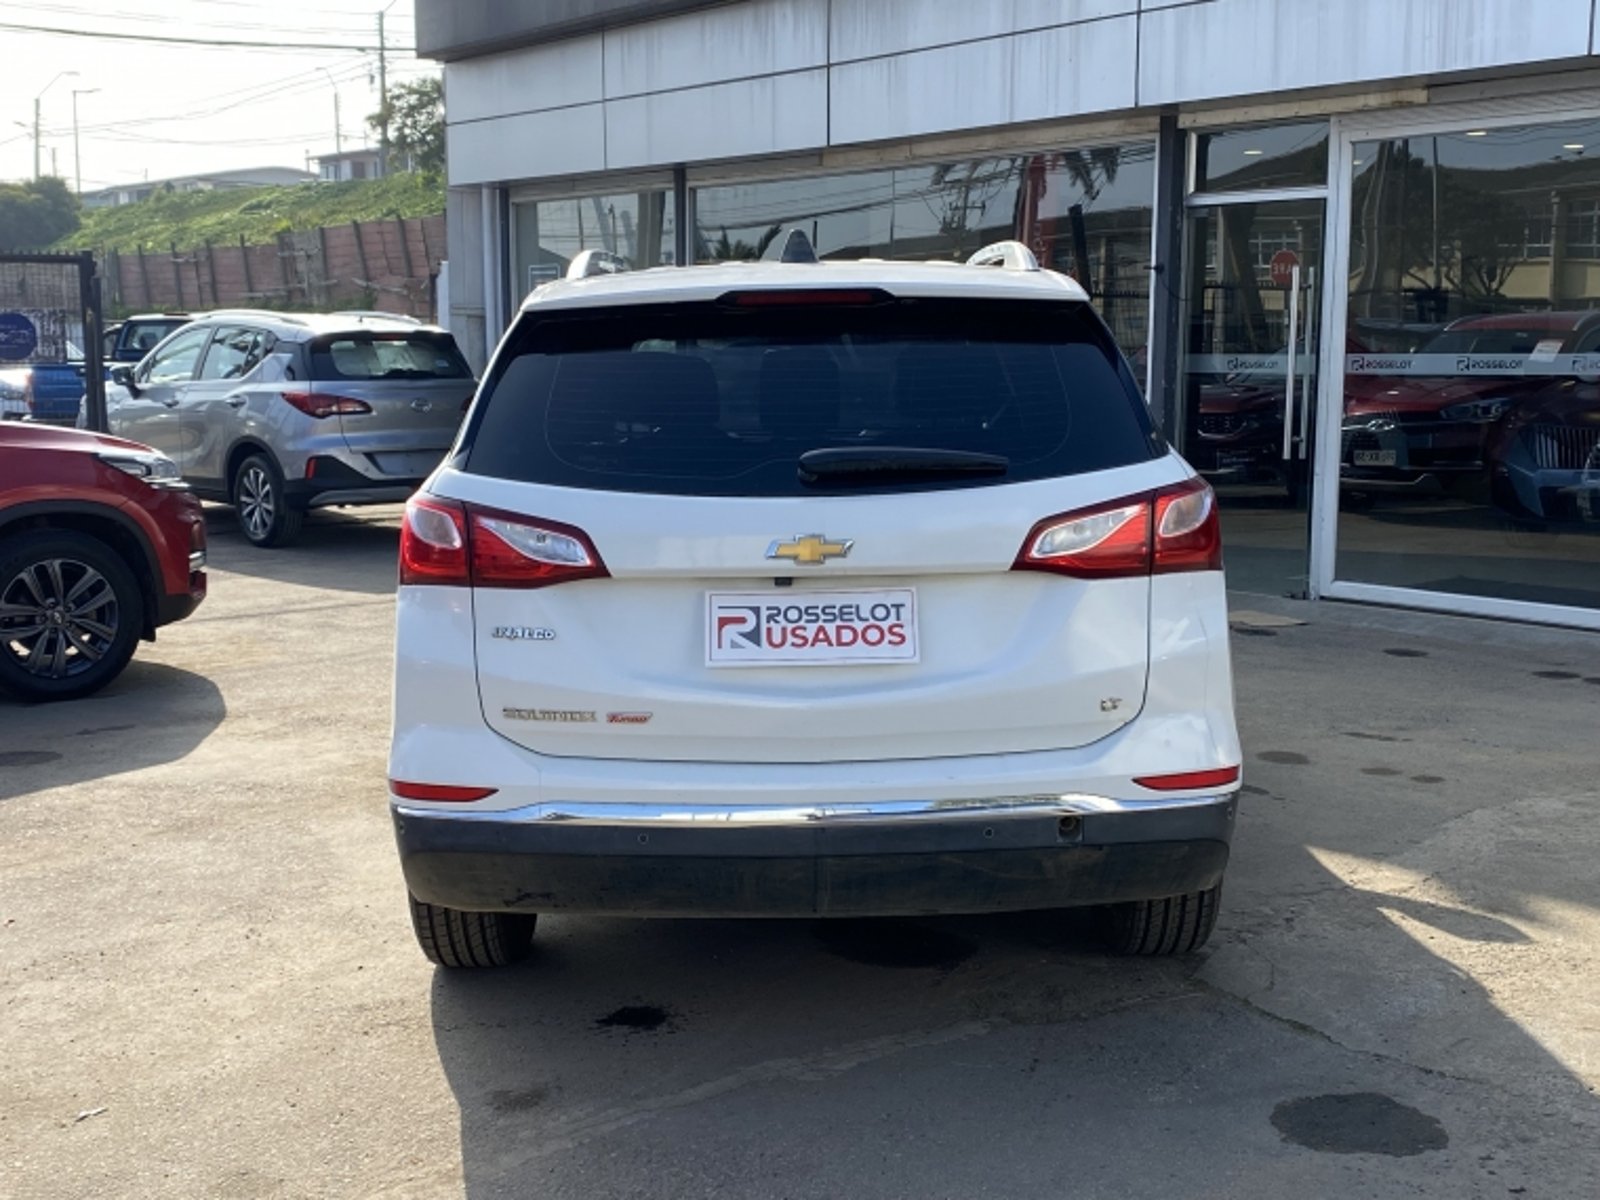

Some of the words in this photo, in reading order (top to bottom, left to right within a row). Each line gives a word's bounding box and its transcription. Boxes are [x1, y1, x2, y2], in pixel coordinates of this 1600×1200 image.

[1365, 360, 1415, 370] ROSSELOT
[1471, 359, 1523, 370] ROSSELOT
[765, 603, 906, 624] ROSSELOT
[765, 623, 907, 649] USADOS
